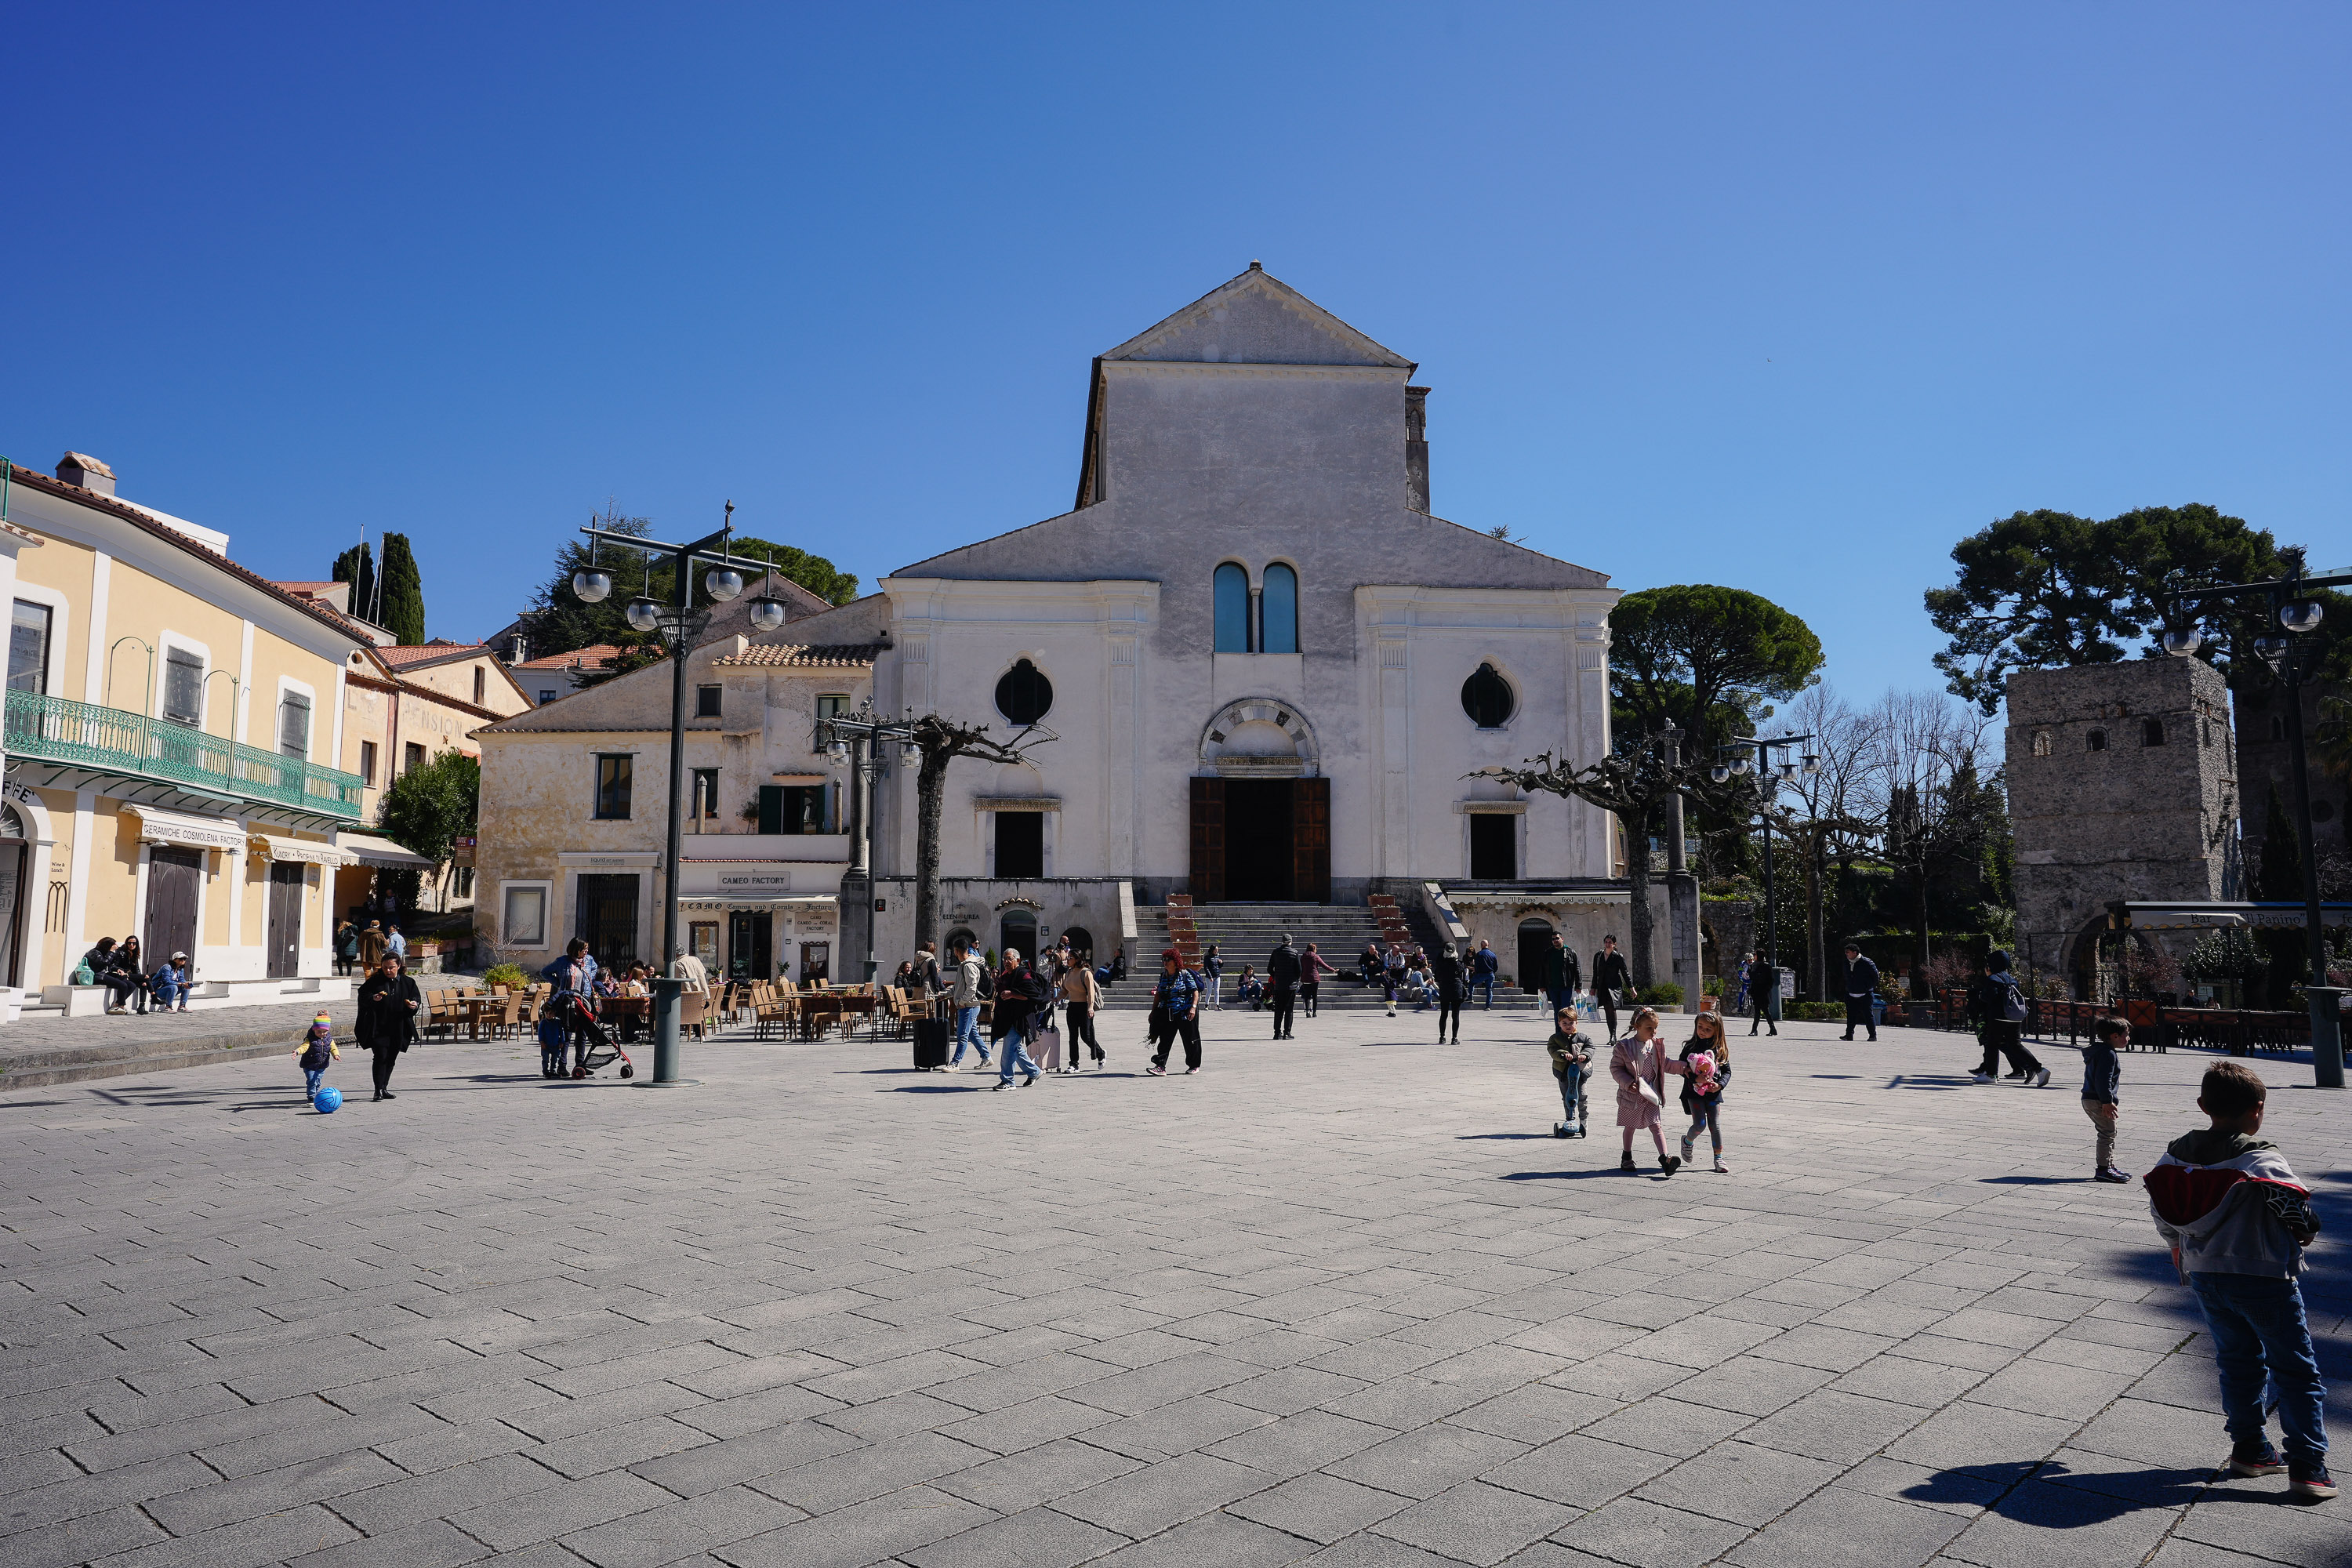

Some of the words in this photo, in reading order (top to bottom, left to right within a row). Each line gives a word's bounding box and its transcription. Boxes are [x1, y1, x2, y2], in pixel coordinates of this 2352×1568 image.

[143, 824, 180, 838] CERAMICHE
[183, 829, 218, 844] COSMOLENA
[220, 835, 245, 847] FACTORY
[2190, 913, 2212, 924] Bar
